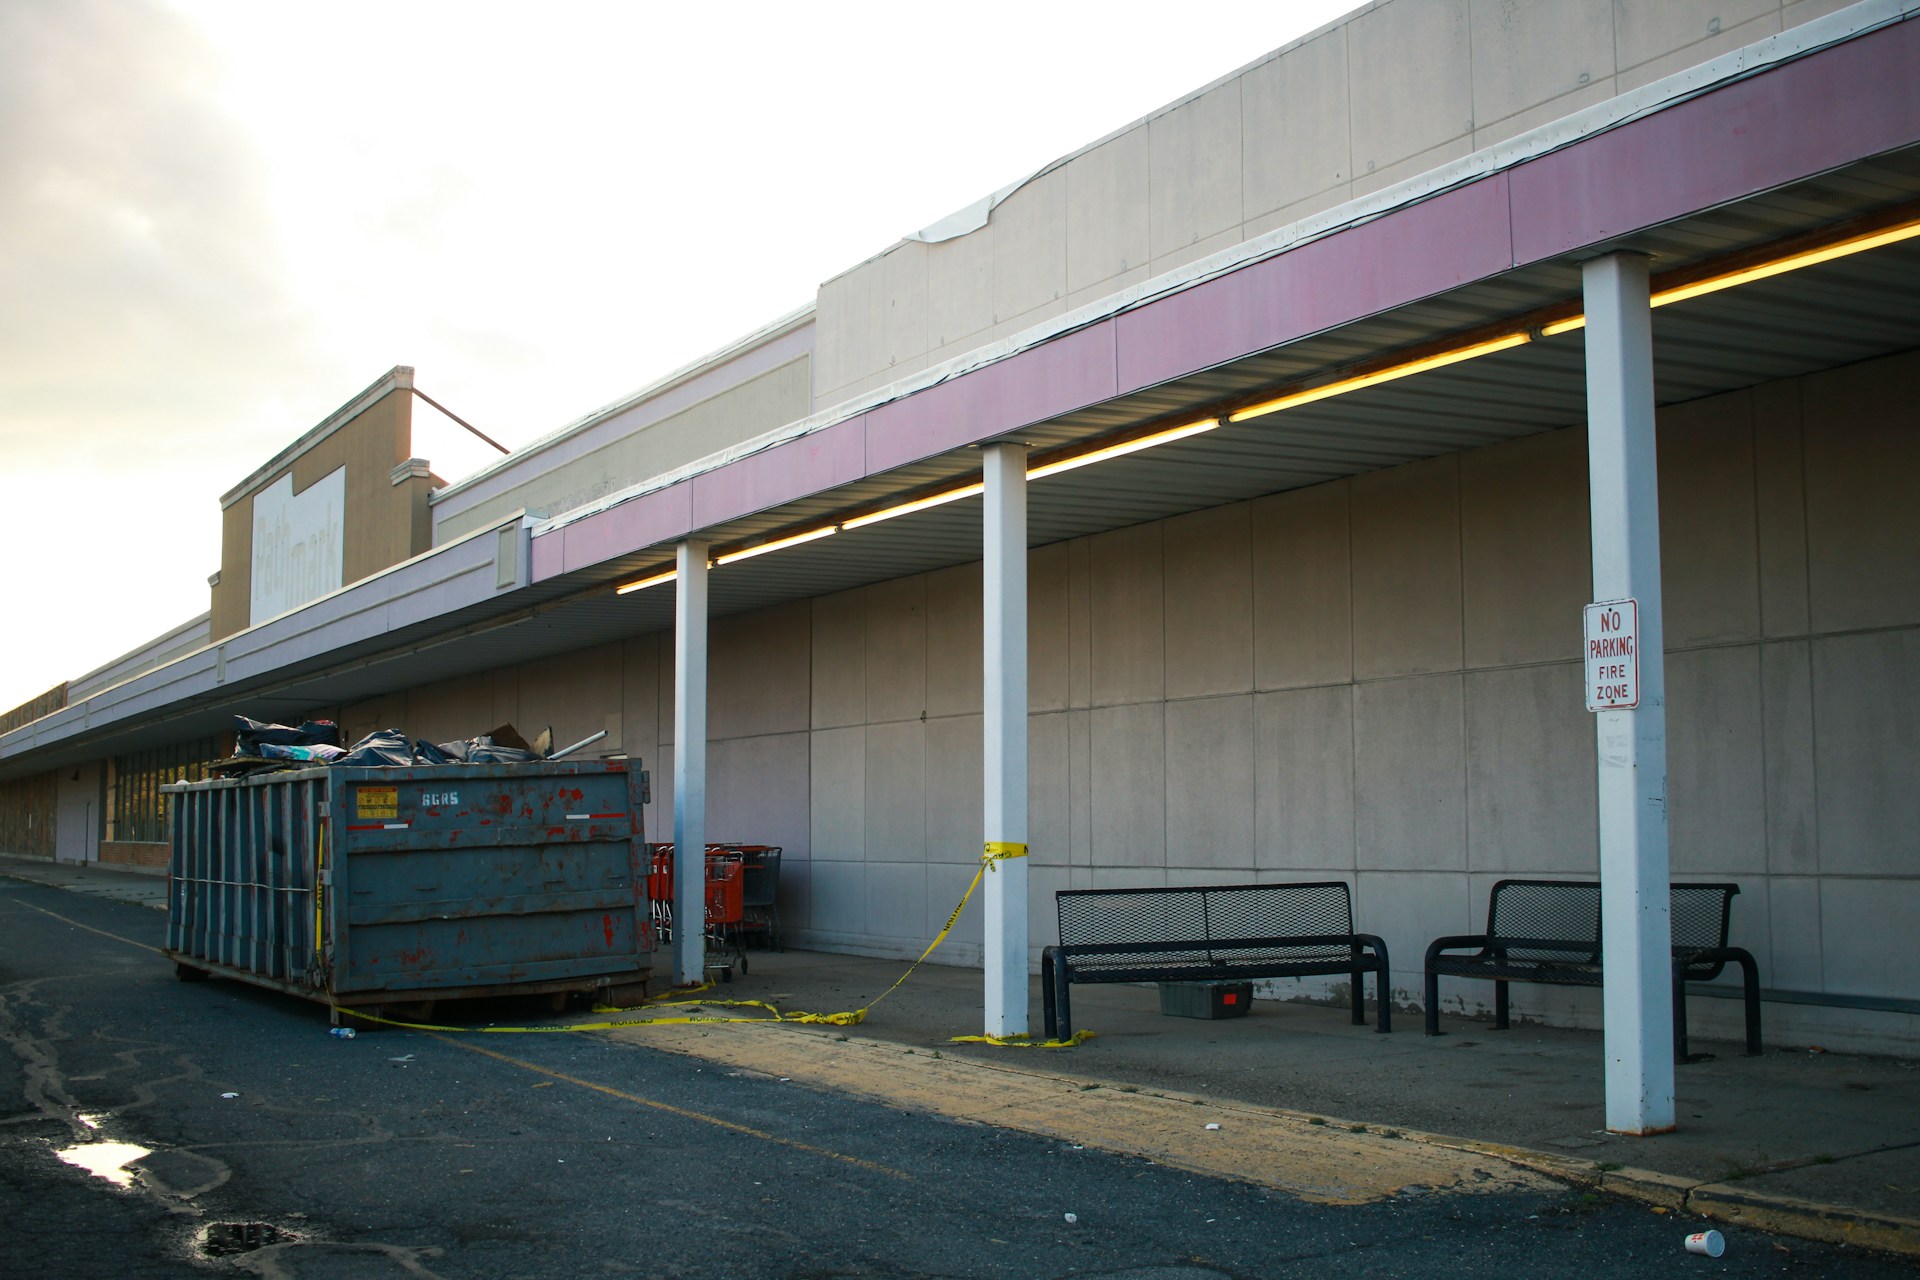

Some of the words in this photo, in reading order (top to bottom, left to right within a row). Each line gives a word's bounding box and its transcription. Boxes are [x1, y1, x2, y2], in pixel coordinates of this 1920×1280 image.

[1600, 611, 1621, 632] NO
[1590, 635, 1633, 659] PARKING
[1599, 664, 1626, 679] FIRE
[1596, 683, 1629, 700] ZONE
